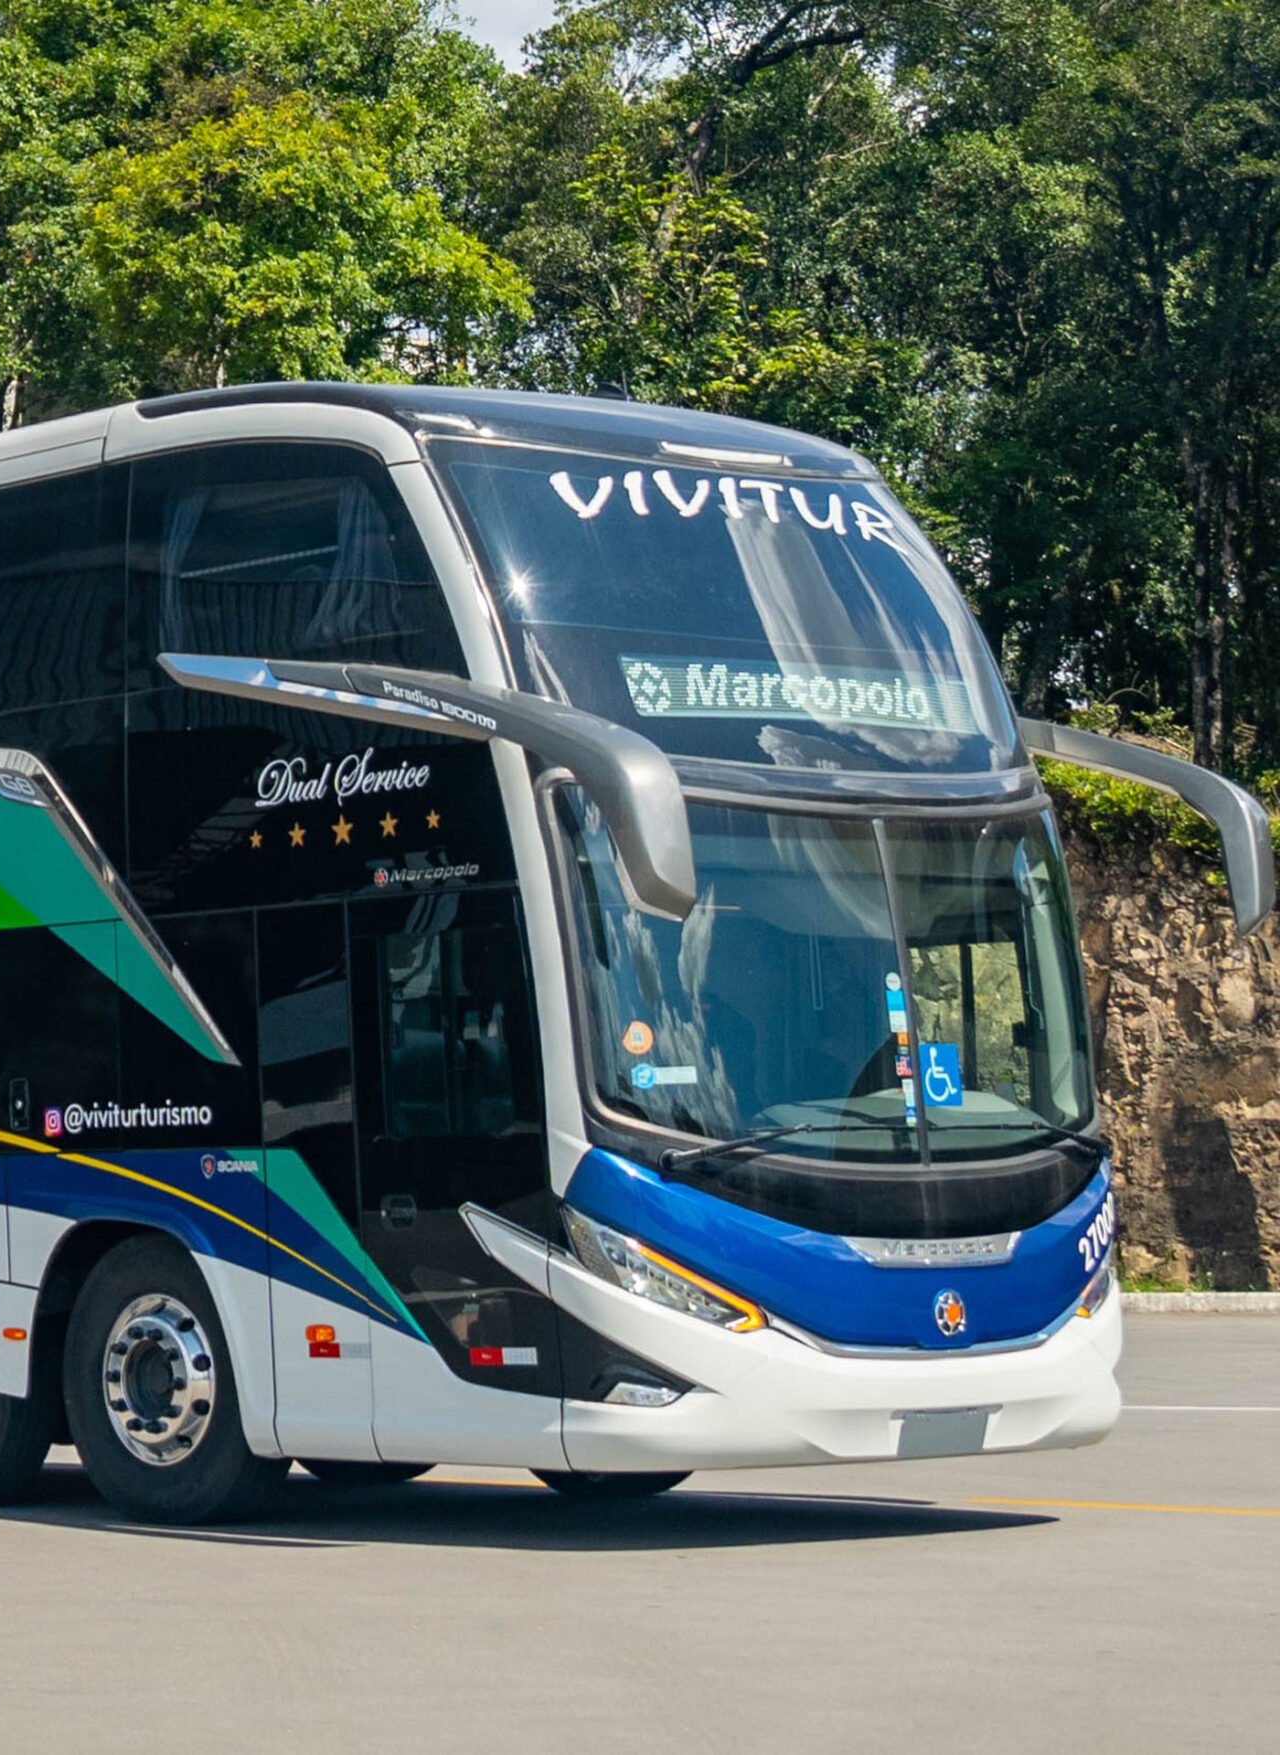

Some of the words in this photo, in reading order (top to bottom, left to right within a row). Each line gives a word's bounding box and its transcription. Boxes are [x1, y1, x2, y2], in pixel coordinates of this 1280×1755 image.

[549, 470, 909, 556] VIVITUR
[382, 680, 440, 710] Paradiso
[685, 663, 930, 721] Marcopolo
[255, 757, 330, 808] Dual
[335, 747, 431, 806] Service
[389, 862, 480, 883] Marcopolo
[64, 1099, 212, 1134] @viviturturismo
[217, 1160, 259, 1173] SCANIA
